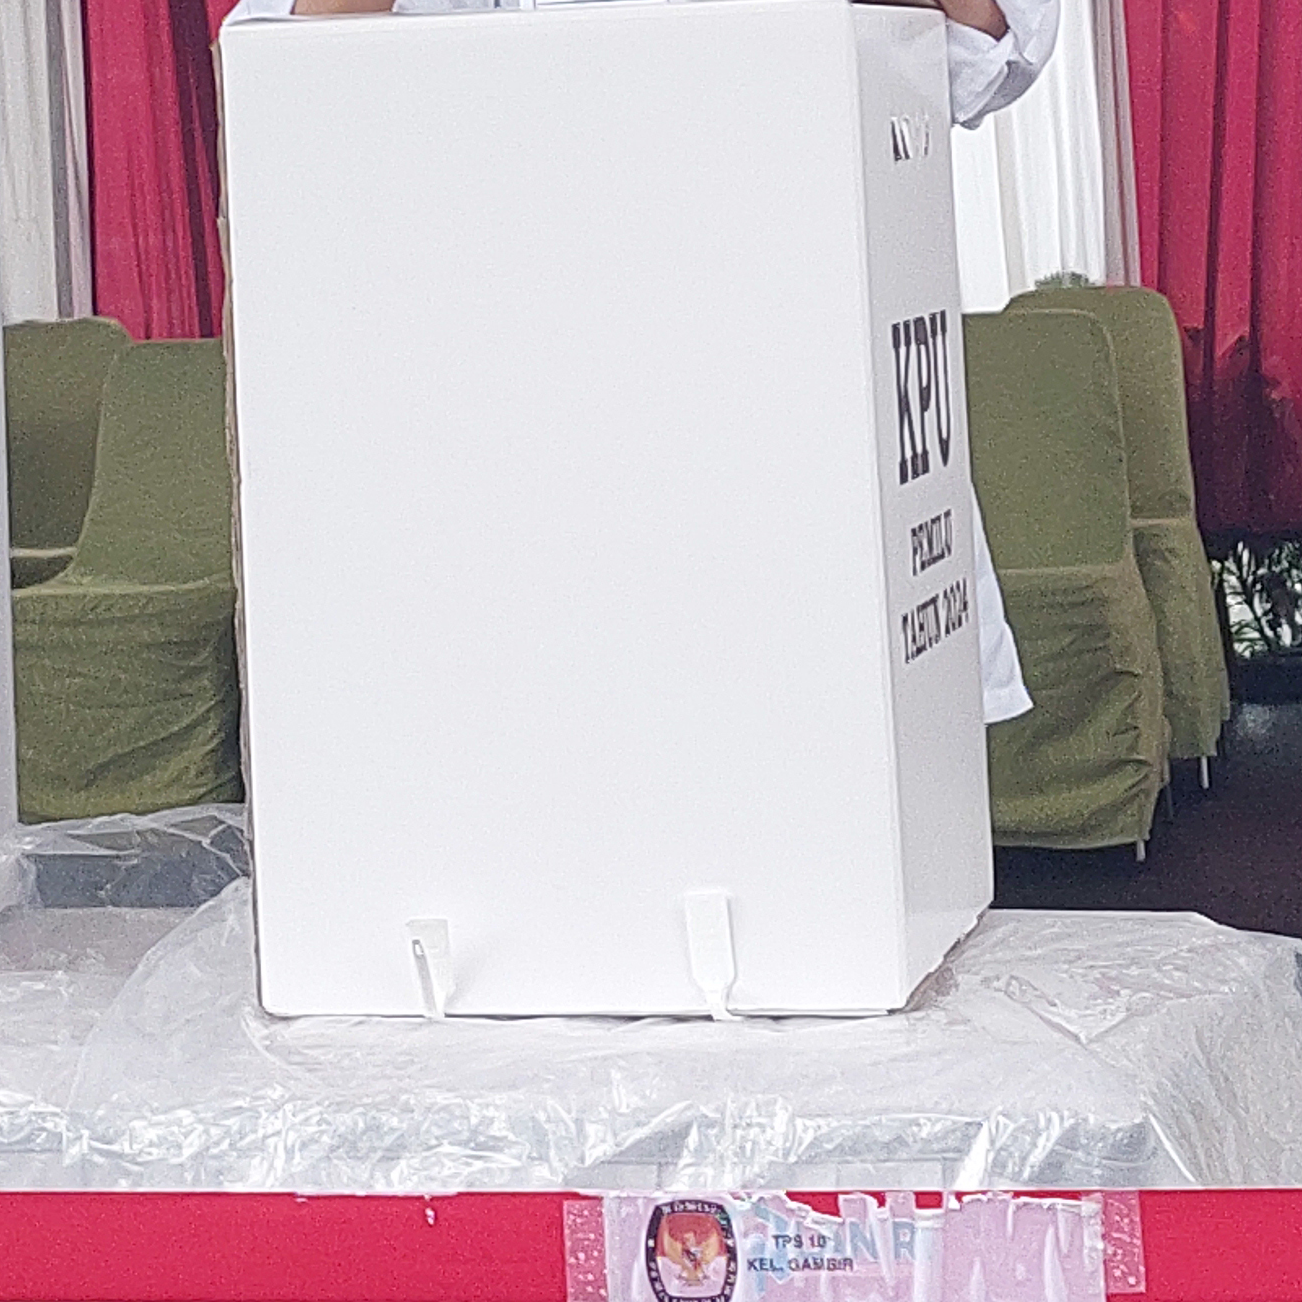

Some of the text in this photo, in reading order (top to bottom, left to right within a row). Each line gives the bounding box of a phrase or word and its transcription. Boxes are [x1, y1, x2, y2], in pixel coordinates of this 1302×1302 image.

[891, 309, 951, 486] KPU
[910, 508, 953, 577] PEMILU
[900, 577, 971, 665] TAHUN 2024
[771, 1234, 803, 1250] TPS
